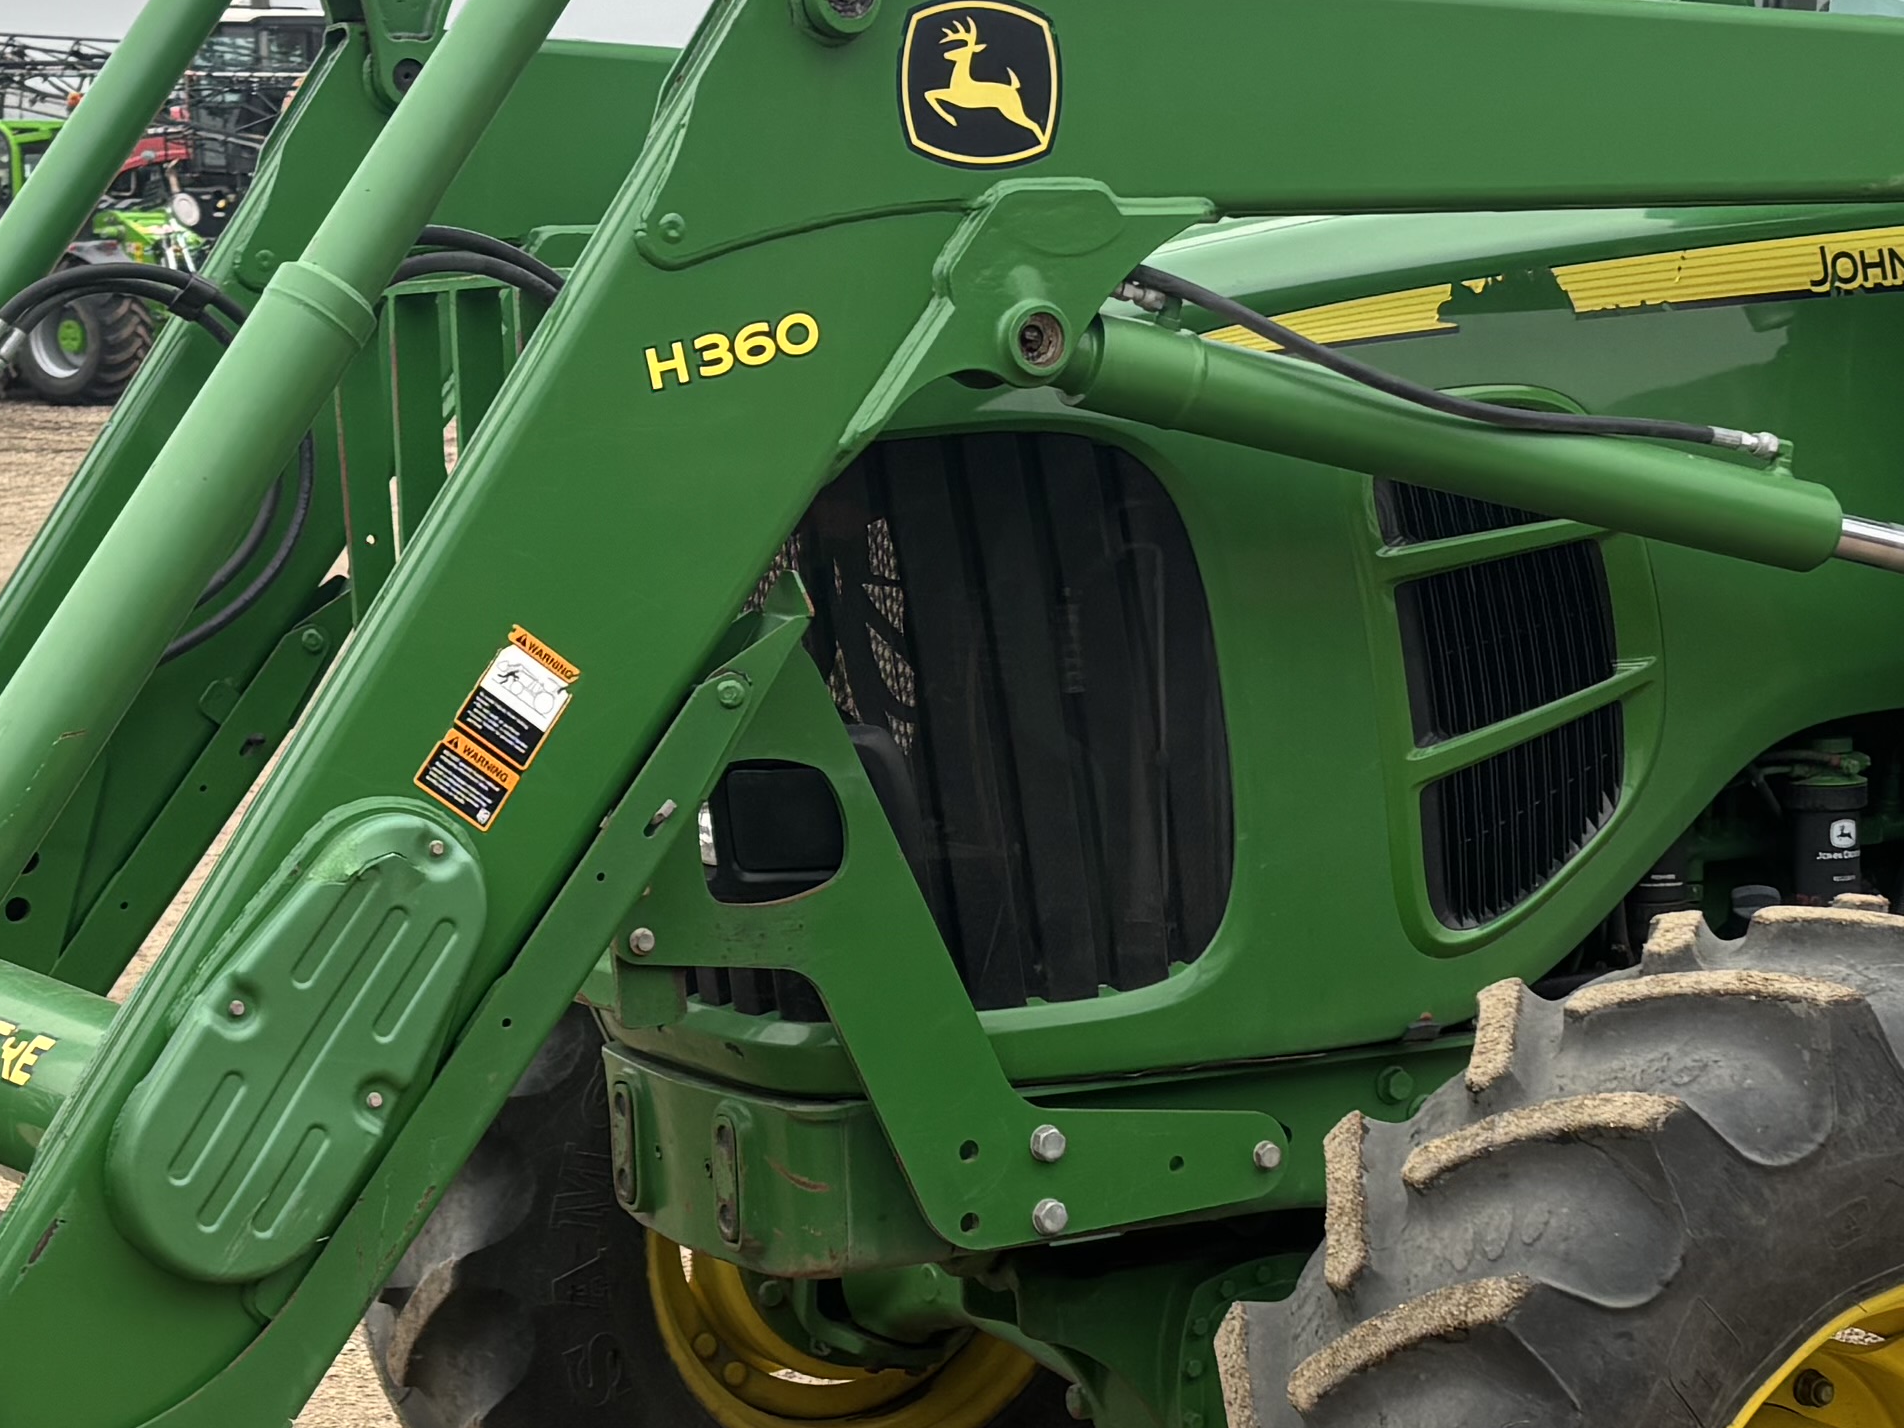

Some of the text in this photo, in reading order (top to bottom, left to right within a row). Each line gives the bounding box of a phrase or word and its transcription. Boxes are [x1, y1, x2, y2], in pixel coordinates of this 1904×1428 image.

[644, 311, 820, 391] H360
[528, 641, 574, 680] WARNING
[462, 744, 509, 783] WARNING
